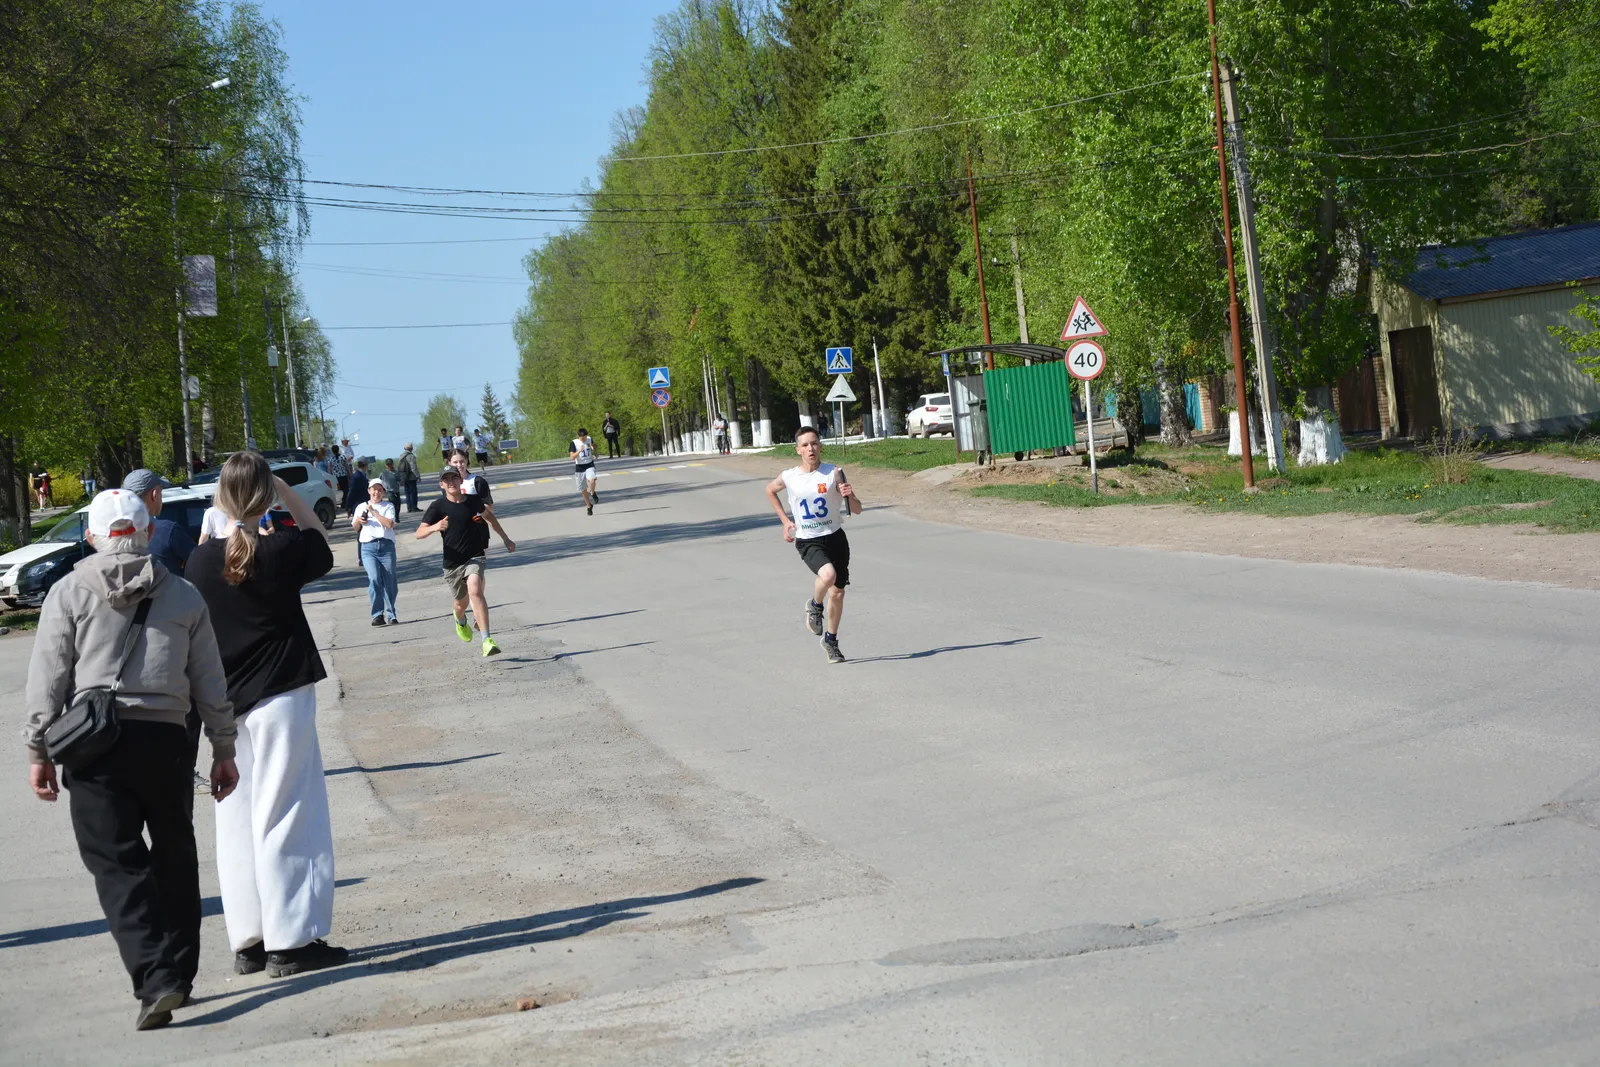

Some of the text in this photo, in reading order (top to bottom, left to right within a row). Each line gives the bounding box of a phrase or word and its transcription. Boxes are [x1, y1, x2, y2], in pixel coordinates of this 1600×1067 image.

[1074, 352, 1098, 368] 40
[582, 448, 590, 458] 17
[799, 497, 828, 519] 13
